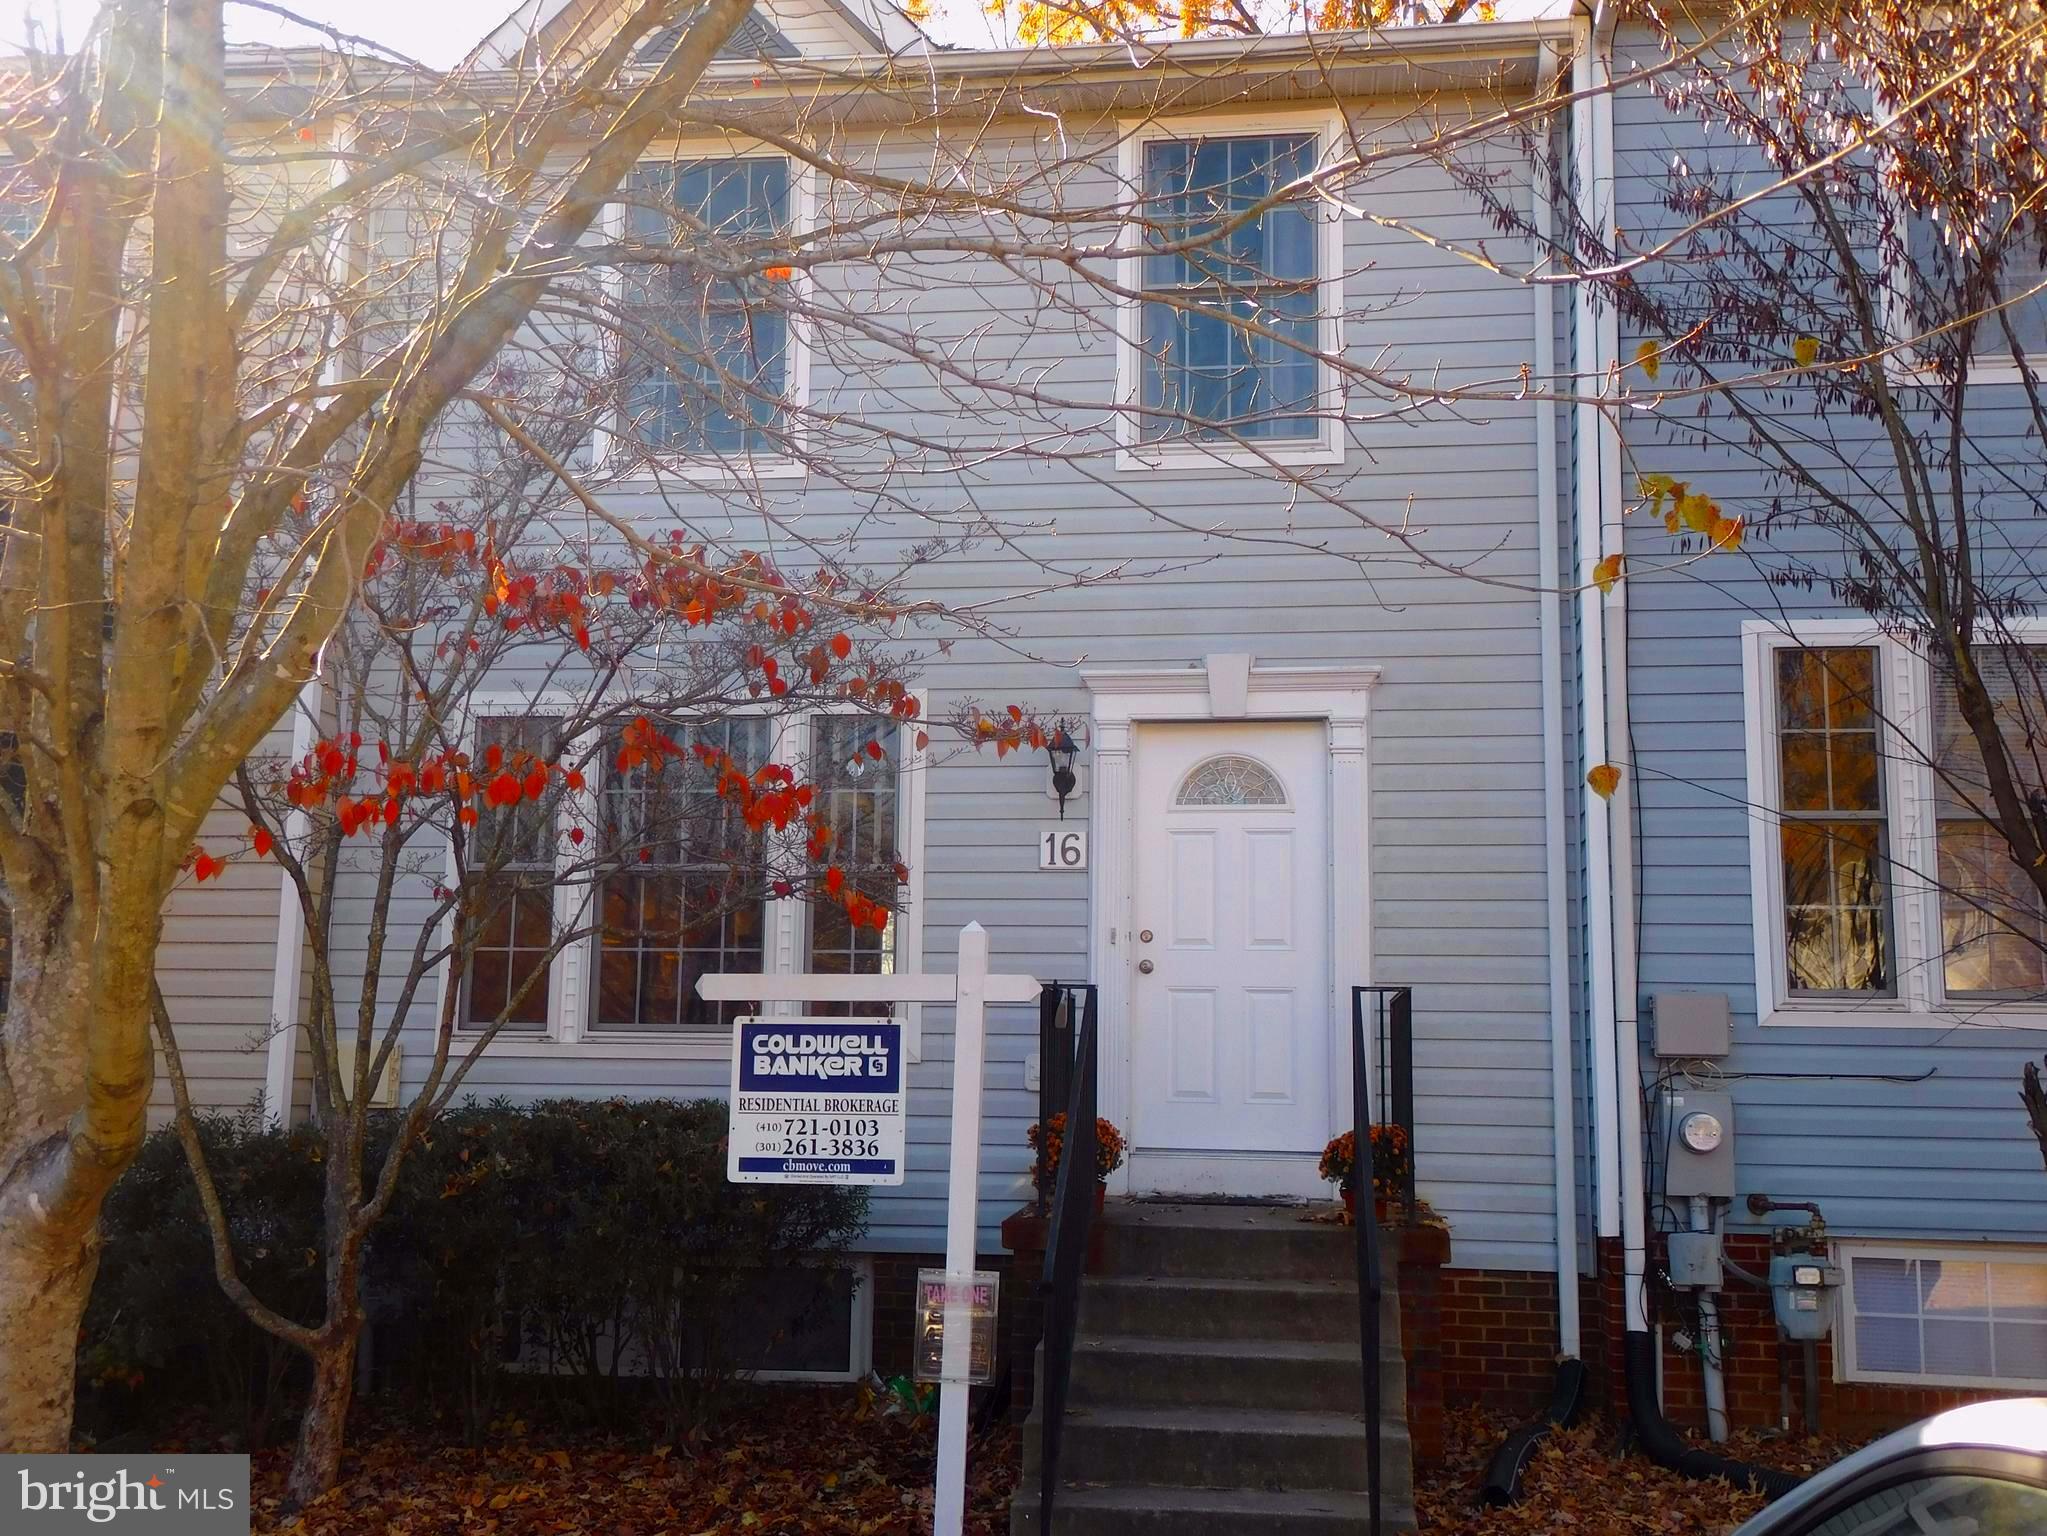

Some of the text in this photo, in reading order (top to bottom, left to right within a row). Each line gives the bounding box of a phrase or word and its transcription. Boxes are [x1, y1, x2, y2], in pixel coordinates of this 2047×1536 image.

[1046, 833, 1080, 865] 16
[739, 1097, 899, 1112] RESIDENTIAL BROKERAGE
[756, 1119, 879, 1136] (410) 721-0103
[755, 1139, 879, 1156] (301) 261-3836
[783, 1159, 851, 1172] cbmove.com
